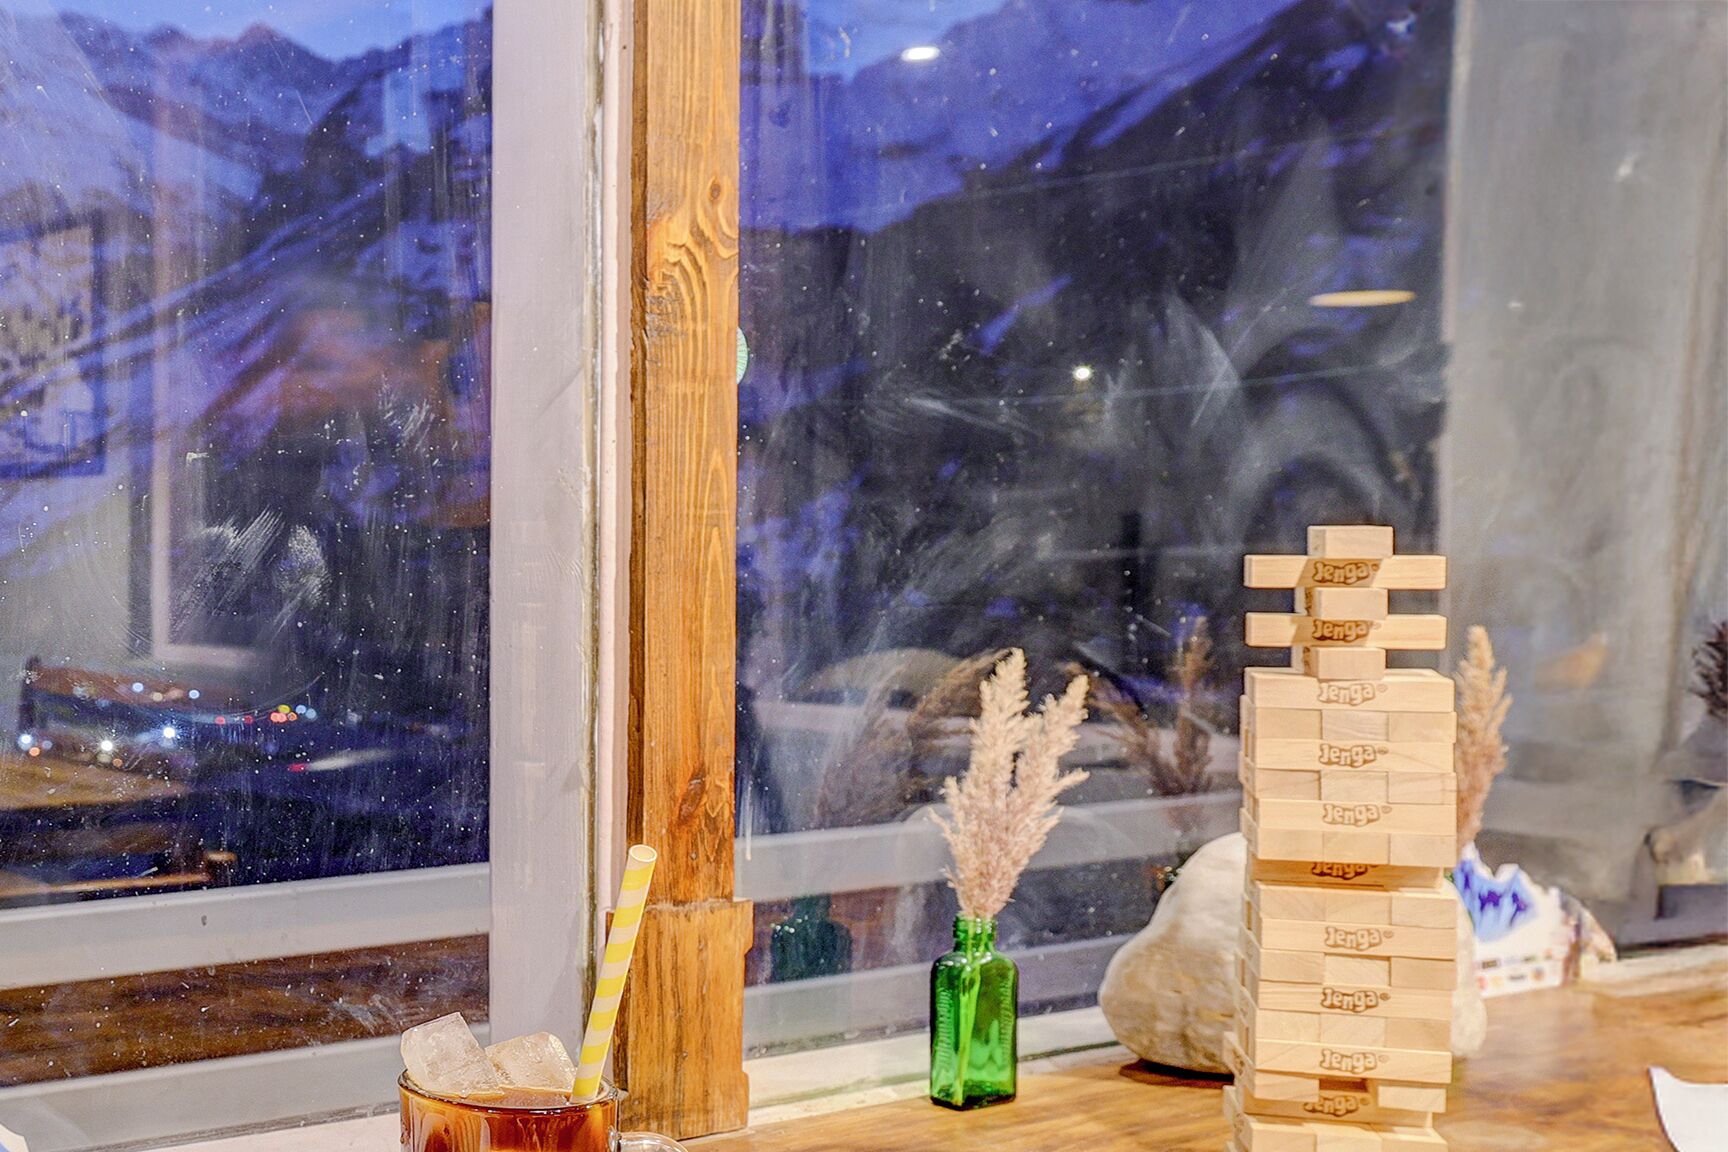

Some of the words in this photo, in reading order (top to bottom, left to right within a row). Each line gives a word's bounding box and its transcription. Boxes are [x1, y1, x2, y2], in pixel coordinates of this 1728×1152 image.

[1312, 561, 1370, 585] Jenga
[1312, 619, 1370, 643] Jenga
[1317, 682, 1376, 706] Jenga
[1319, 743, 1377, 768] Jenga
[1322, 803, 1381, 827] Jenga
[1325, 926, 1382, 951] Jenga
[1321, 987, 1379, 1013] Jenga
[1320, 1048, 1378, 1075] Jenga
